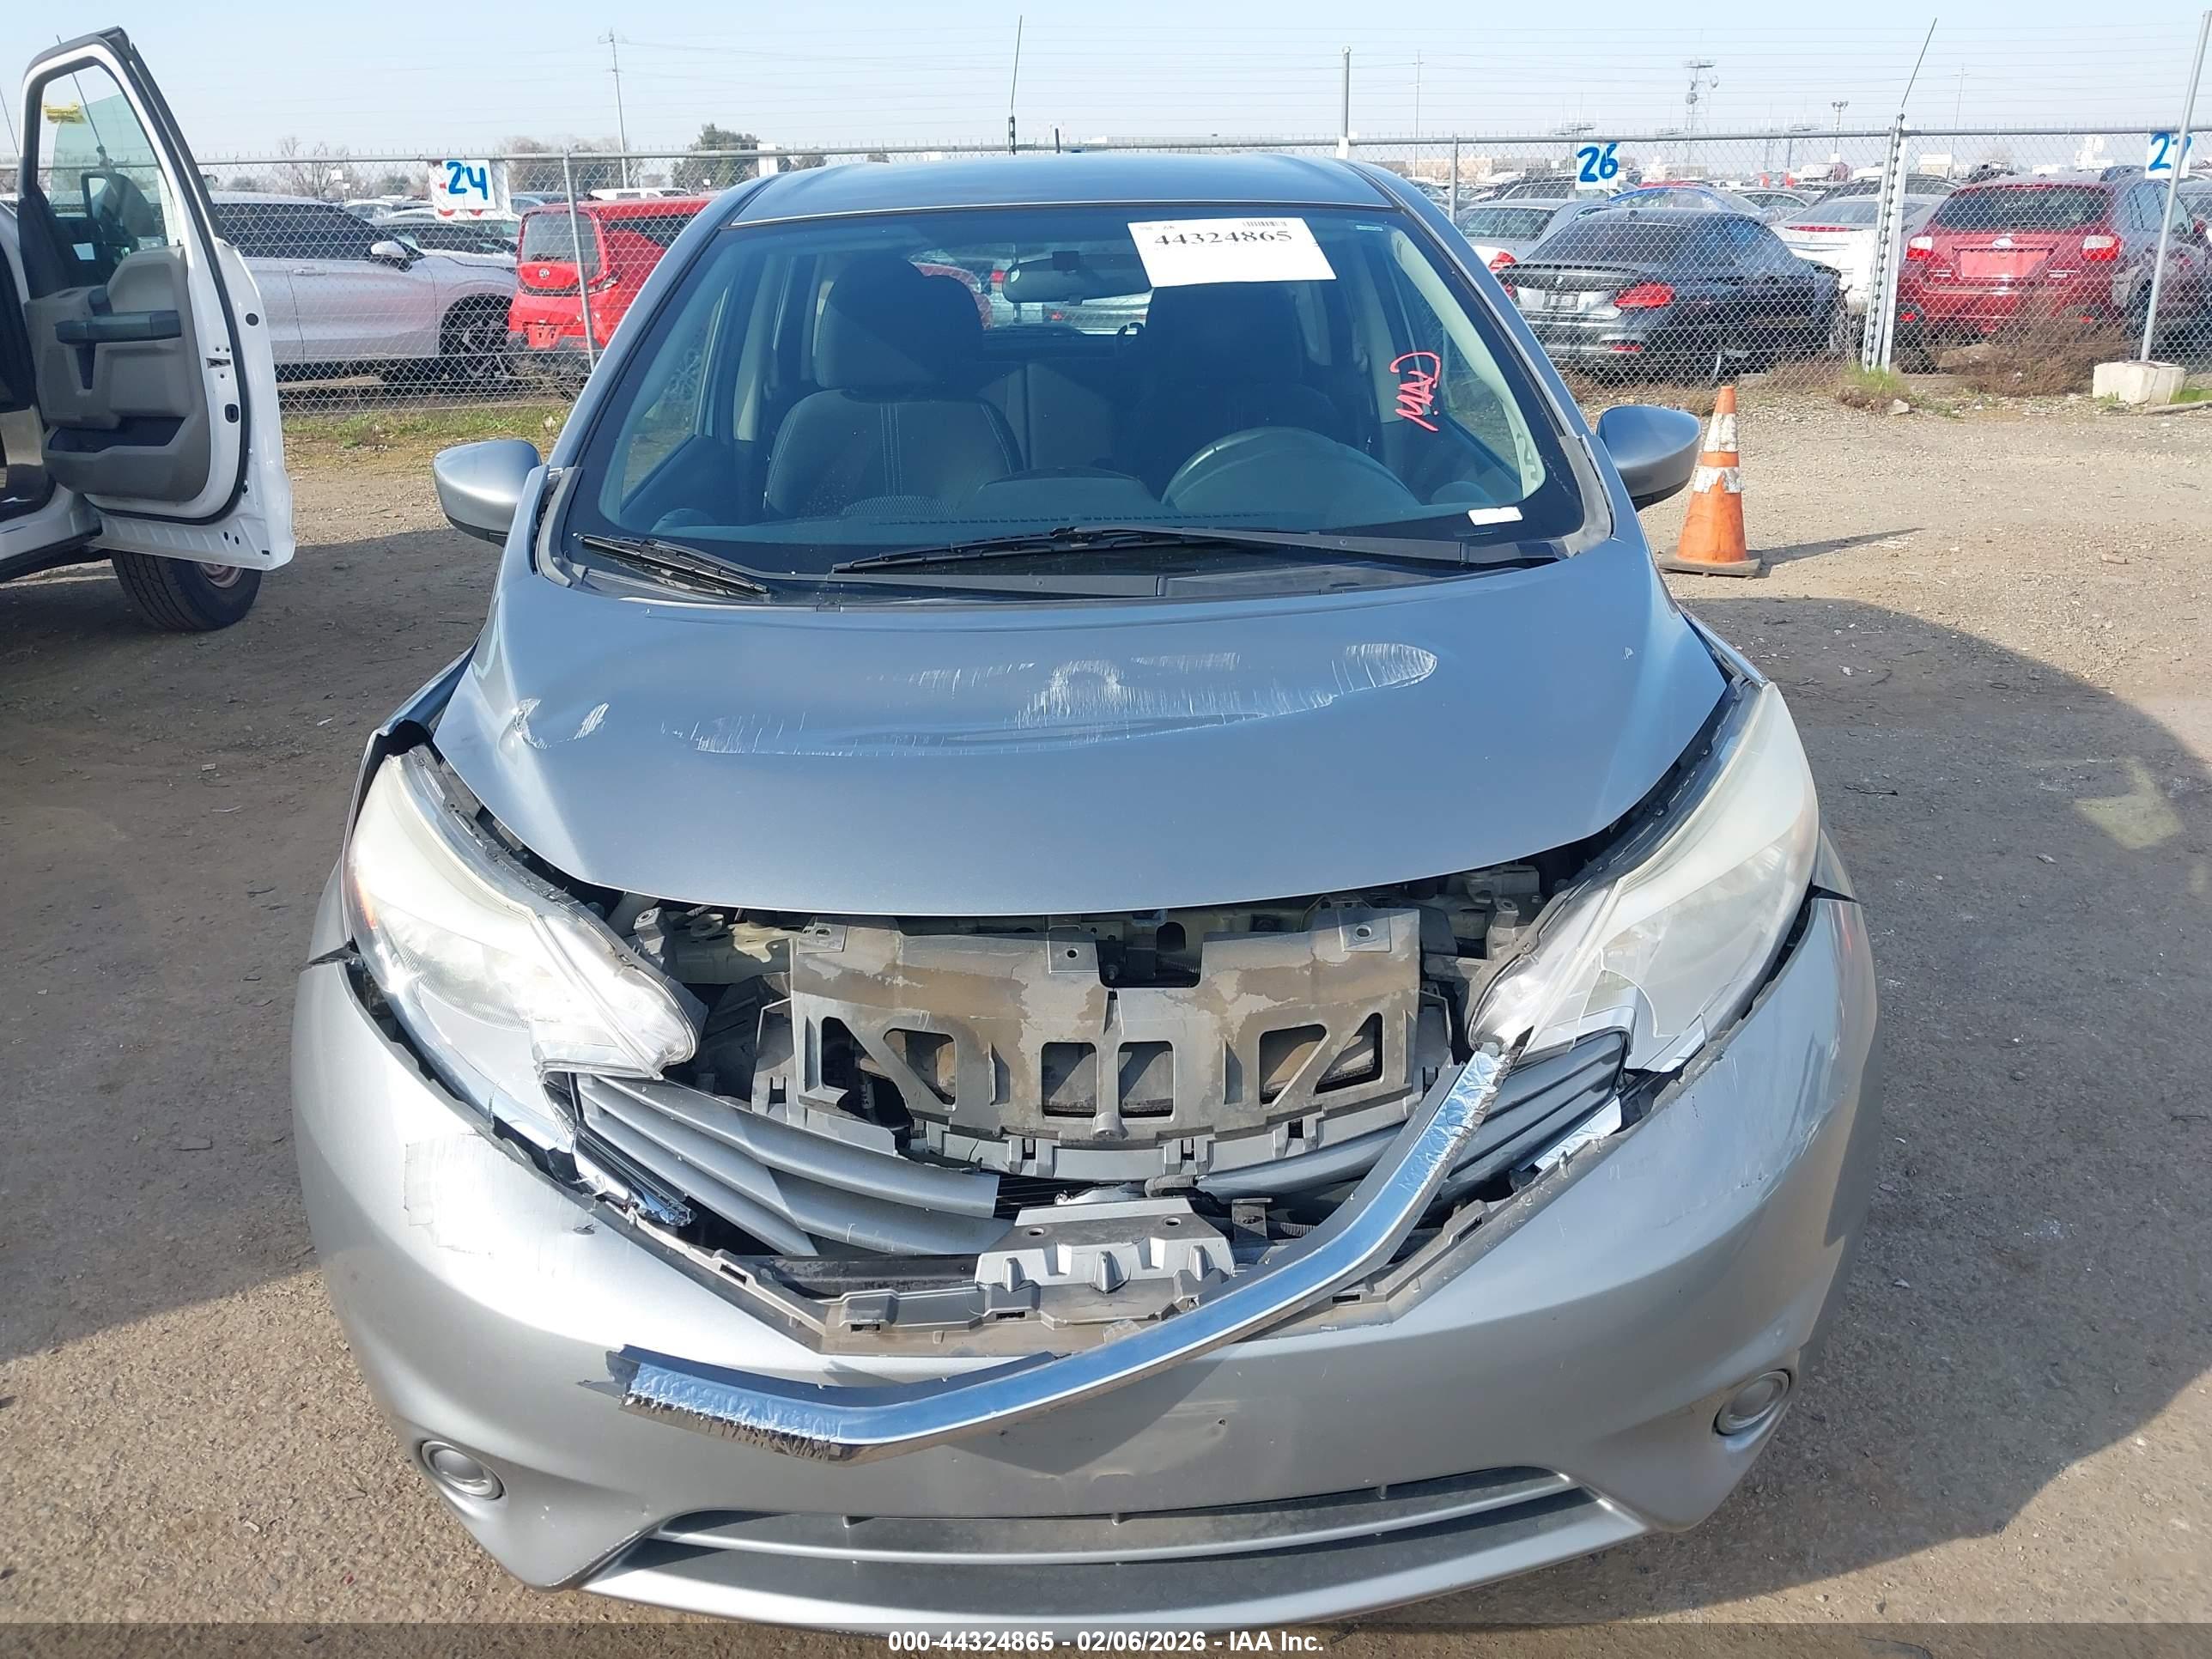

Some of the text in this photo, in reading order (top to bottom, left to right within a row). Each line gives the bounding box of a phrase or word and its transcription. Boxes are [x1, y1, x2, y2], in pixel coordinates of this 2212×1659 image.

[446, 161, 488, 200] 24
[1577, 142, 1619, 182] 26
[1154, 231, 1292, 246] 44324865
